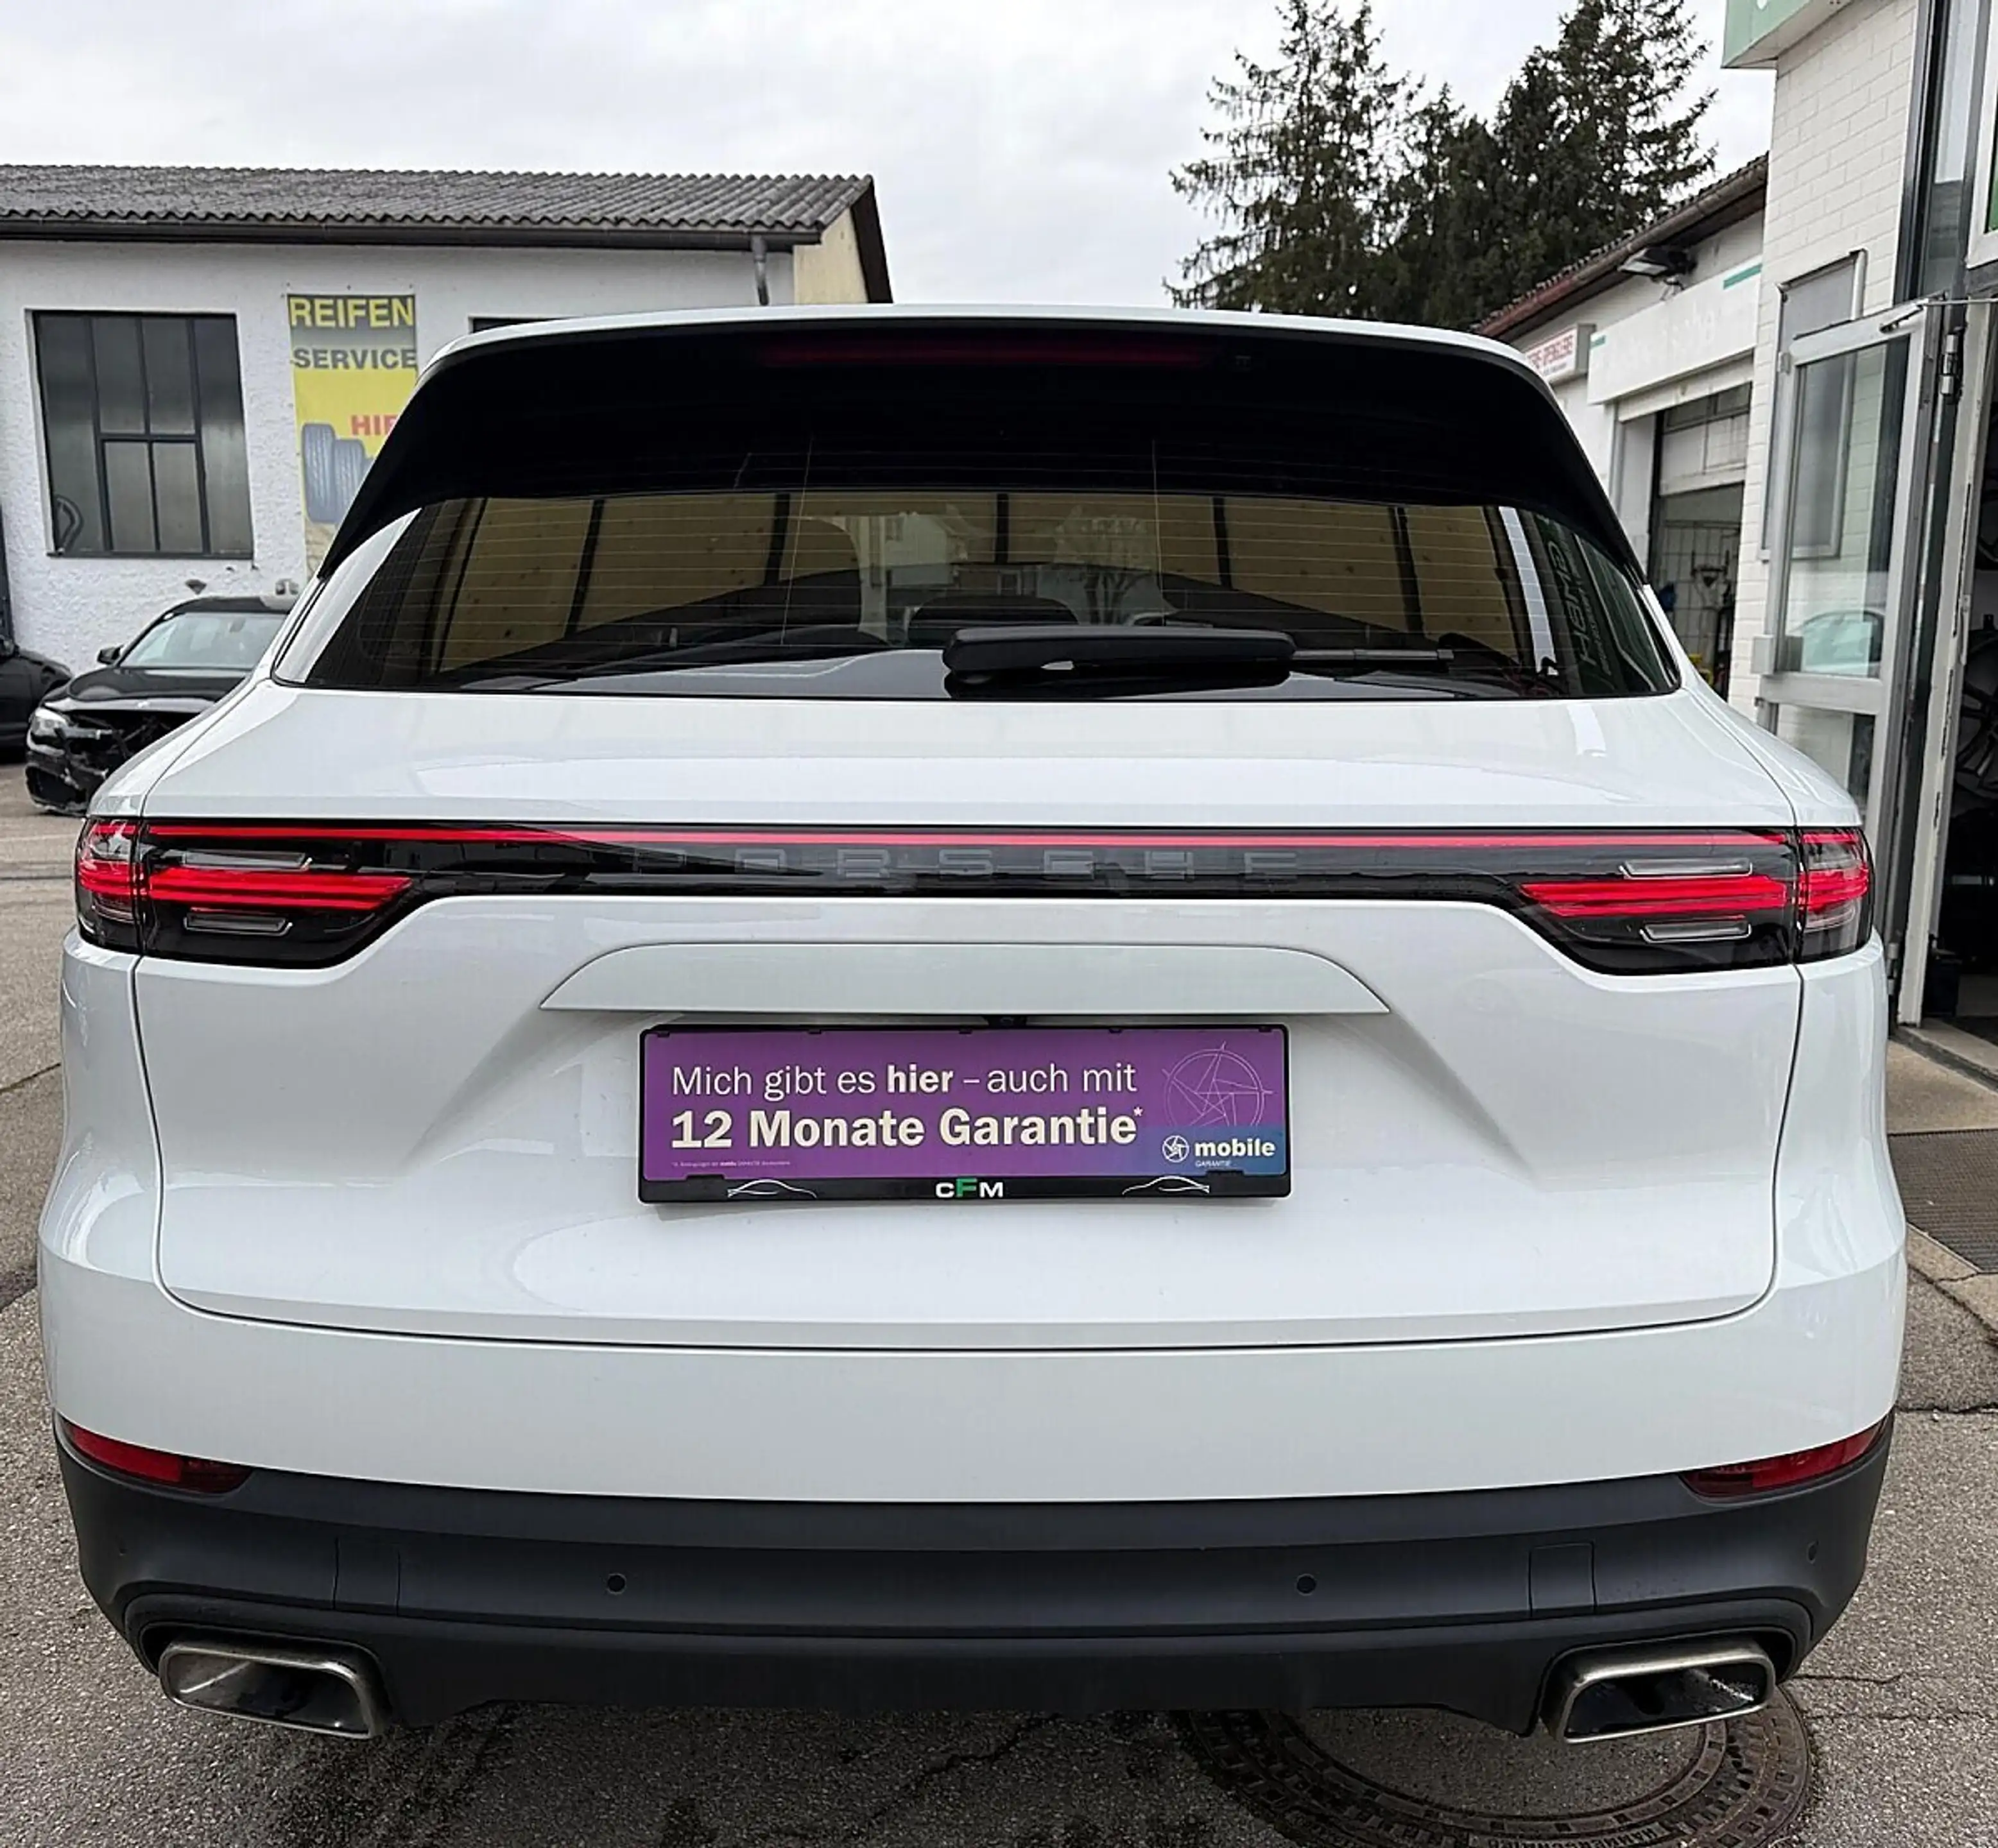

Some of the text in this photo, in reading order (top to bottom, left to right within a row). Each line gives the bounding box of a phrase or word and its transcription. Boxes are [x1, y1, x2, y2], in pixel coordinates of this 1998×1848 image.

[289, 297, 414, 329] REIFEN
[293, 348, 417, 370] SERVICE
[633, 847, 1298, 880] PORSCHE
[673, 1066, 752, 1095] Mich
[764, 1065, 827, 1102] gibt
[837, 1070, 876, 1095] es
[887, 1063, 954, 1093] hier
[986, 1063, 1069, 1093] auch
[1083, 1062, 1138, 1092] mit
[671, 1110, 732, 1148] 12
[749, 1110, 926, 1147] Monate
[1194, 1138, 1276, 1157] mobile
[935, 1177, 1004, 1199] CFM
